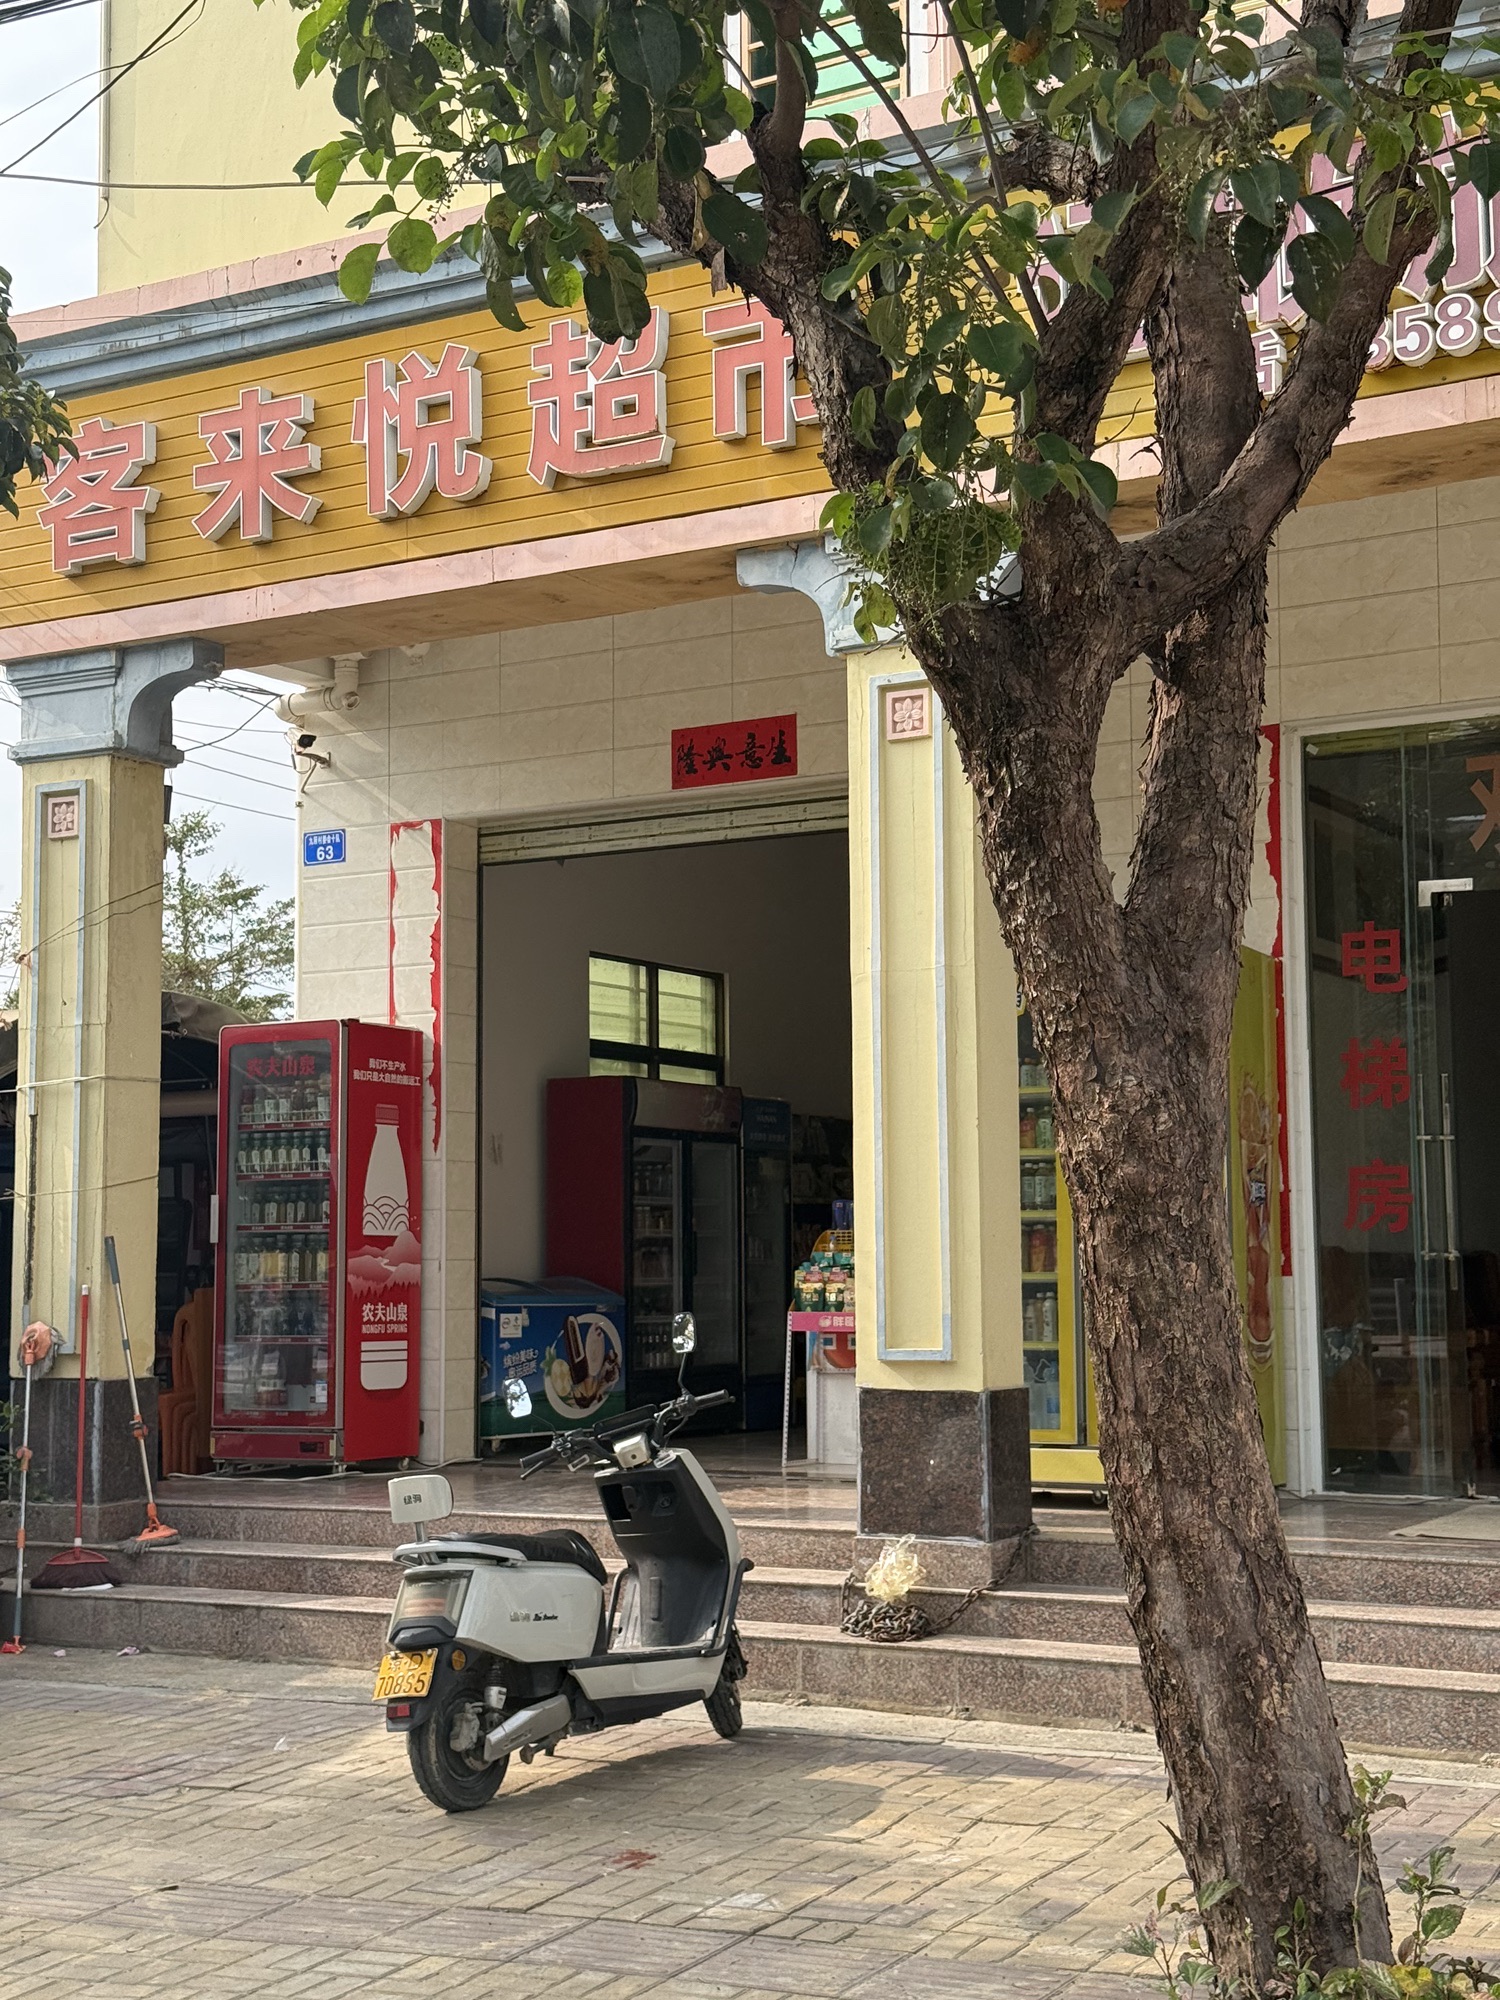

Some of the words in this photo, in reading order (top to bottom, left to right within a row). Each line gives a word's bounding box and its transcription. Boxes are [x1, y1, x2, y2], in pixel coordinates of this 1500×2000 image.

[36, 297, 822, 577] 客来悦超市
[316, 845, 334, 861] 63
[246, 1054, 316, 1078] 农夫山泉
[369, 1058, 406, 1072] 我们不生产水
[1340, 920, 1413, 1233] 电梯房
[362, 1302, 408, 1322] 农夫山泉
[362, 1324, 385, 1334] NONGFU
[387, 1323, 408, 1333] SPRING
